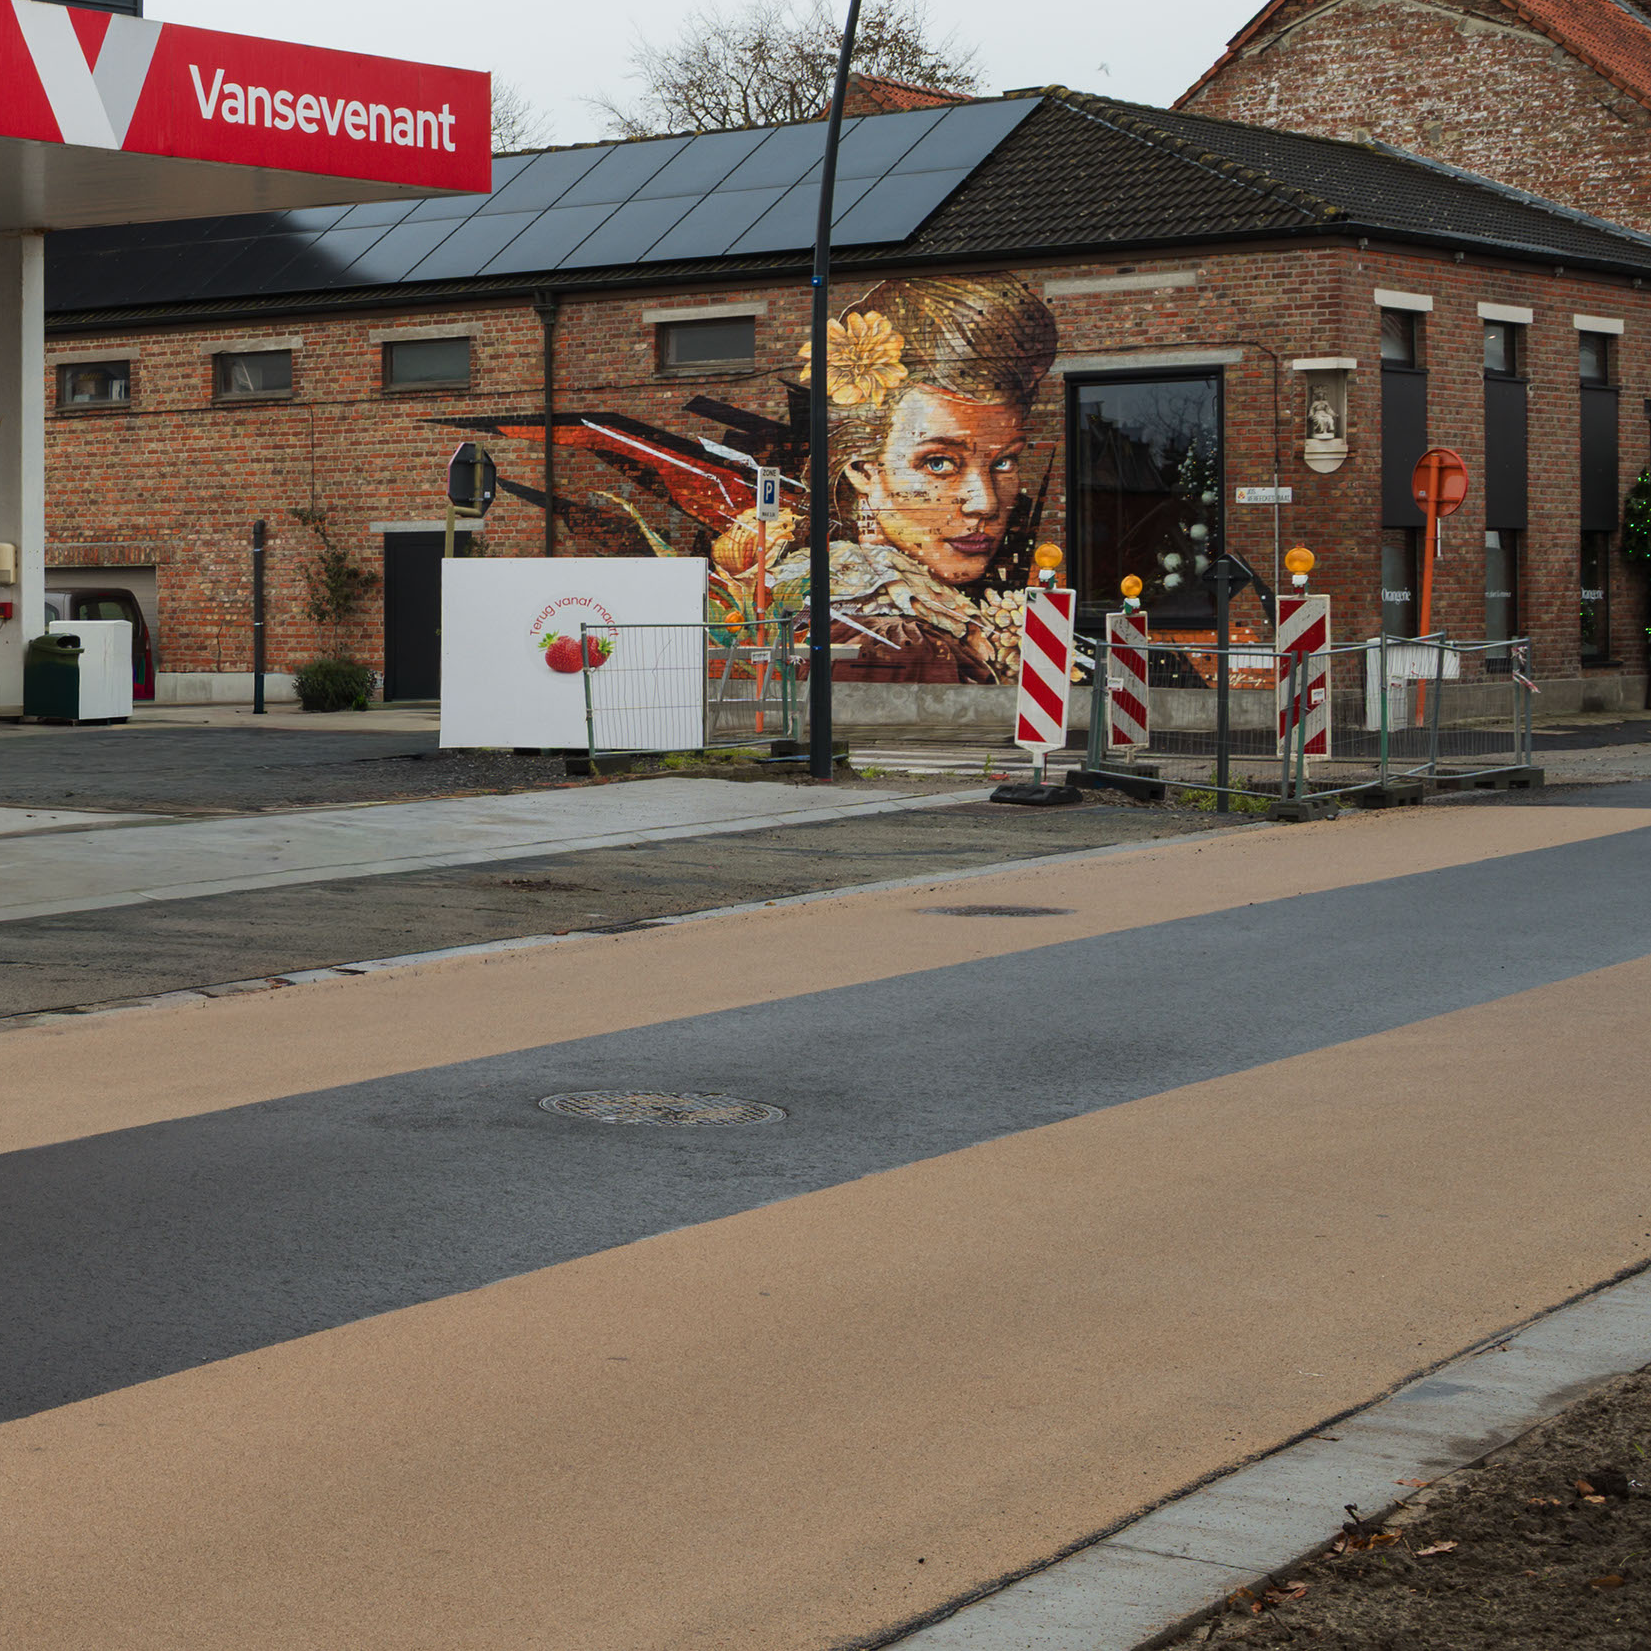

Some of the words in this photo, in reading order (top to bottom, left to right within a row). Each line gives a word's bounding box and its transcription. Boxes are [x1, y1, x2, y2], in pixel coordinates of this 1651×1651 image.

[188, 63, 456, 152] Vansevenant
[529, 605, 556, 636] Terug
[554, 596, 594, 608] vanaf
